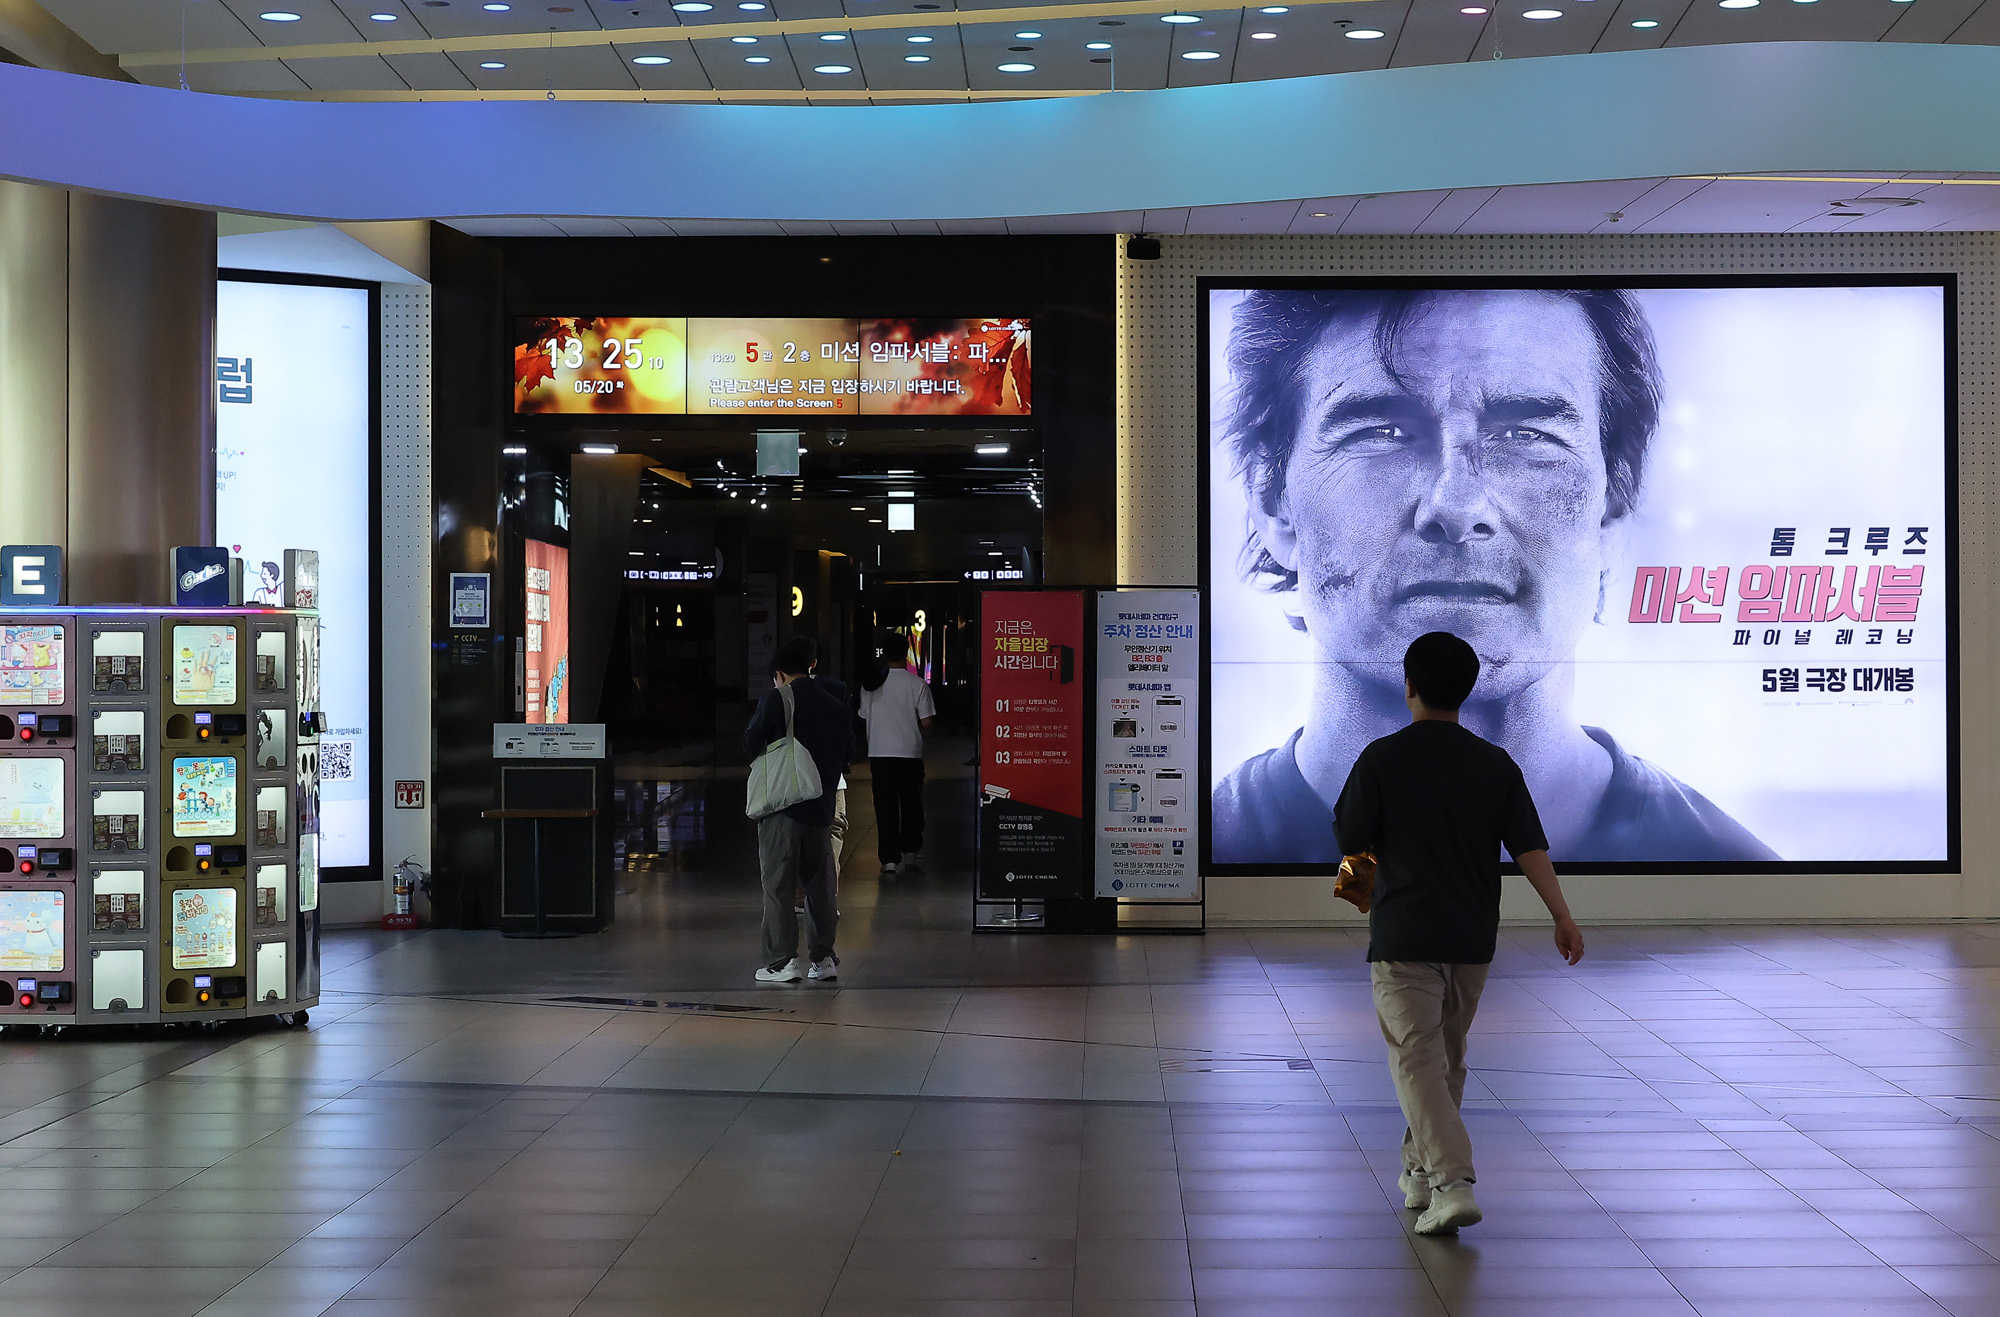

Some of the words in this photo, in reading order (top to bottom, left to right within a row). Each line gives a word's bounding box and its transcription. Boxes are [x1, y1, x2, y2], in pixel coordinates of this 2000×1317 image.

[545, 338, 584, 369] 13
[602, 338, 644, 369] 25
[648, 357, 664, 369] 10
[710, 354, 736, 362] 13:20
[820, 341, 861, 362] 미션
[870, 341, 959, 363] 임파서블:
[968, 342, 1006, 363] 파...
[574, 380, 614, 394] 05/20
[710, 379, 793, 394] 관람고객님은
[798, 378, 826, 394] 지금
[830, 378, 900, 394] 입장하시기
[906, 378, 965, 395] 바랍니다.
[710, 398, 744, 408] Please
[747, 399, 774, 408] enter
[777, 398, 793, 408] the
[796, 398, 833, 408] Screen
[836, 399, 842, 408] 5
[223, 472, 236, 480] UP!
[1770, 527, 1796, 556] 톰
[1824, 526, 1929, 556] 크루즈
[12, 556, 46, 594] E
[1628, 566, 1730, 624] 미션
[1737, 565, 1925, 623] 임파서블
[914, 610, 926, 632] 3
[994, 620, 1036, 635] 지금은,
[1104, 624, 1131, 638] 주차
[1134, 624, 1162, 638] 정산
[1166, 624, 1192, 638] 안내
[1733, 629, 1811, 645] 파이널
[1835, 629, 1914, 645] 레코닝
[1158, 646, 1172, 654] 위치
[994, 655, 1058, 670] 시간입니다
[1762, 668, 1800, 692] 5월
[1806, 668, 1847, 692] 극장
[1853, 668, 1914, 692] 대개봉
[996, 699, 1010, 712] 01
[996, 725, 1010, 738] 02
[996, 751, 1010, 764] 03
